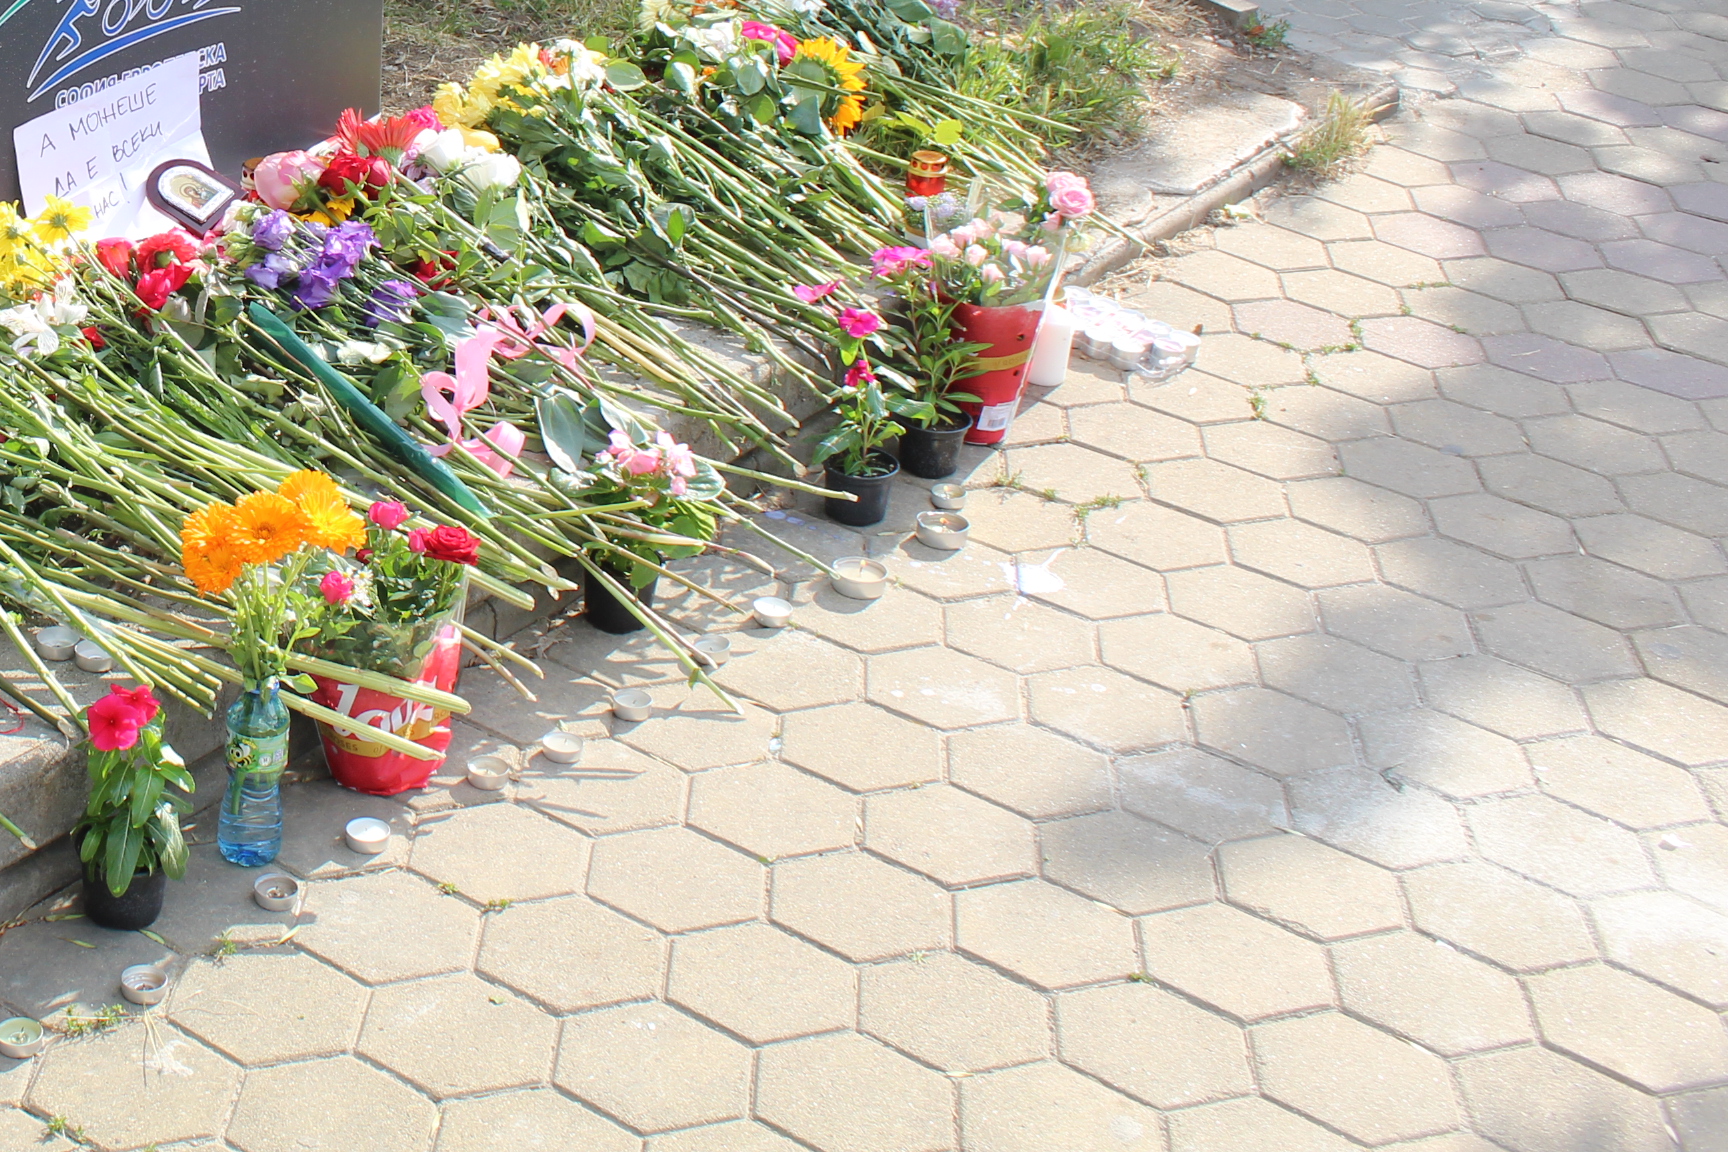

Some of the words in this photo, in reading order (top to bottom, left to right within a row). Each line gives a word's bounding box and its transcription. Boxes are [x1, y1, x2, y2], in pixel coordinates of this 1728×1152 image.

[39, 132, 57, 158] А
[52, 170, 76, 198] ДА
[86, 156, 99, 180] Е
[111, 121, 165, 163] ВСЕКИ
